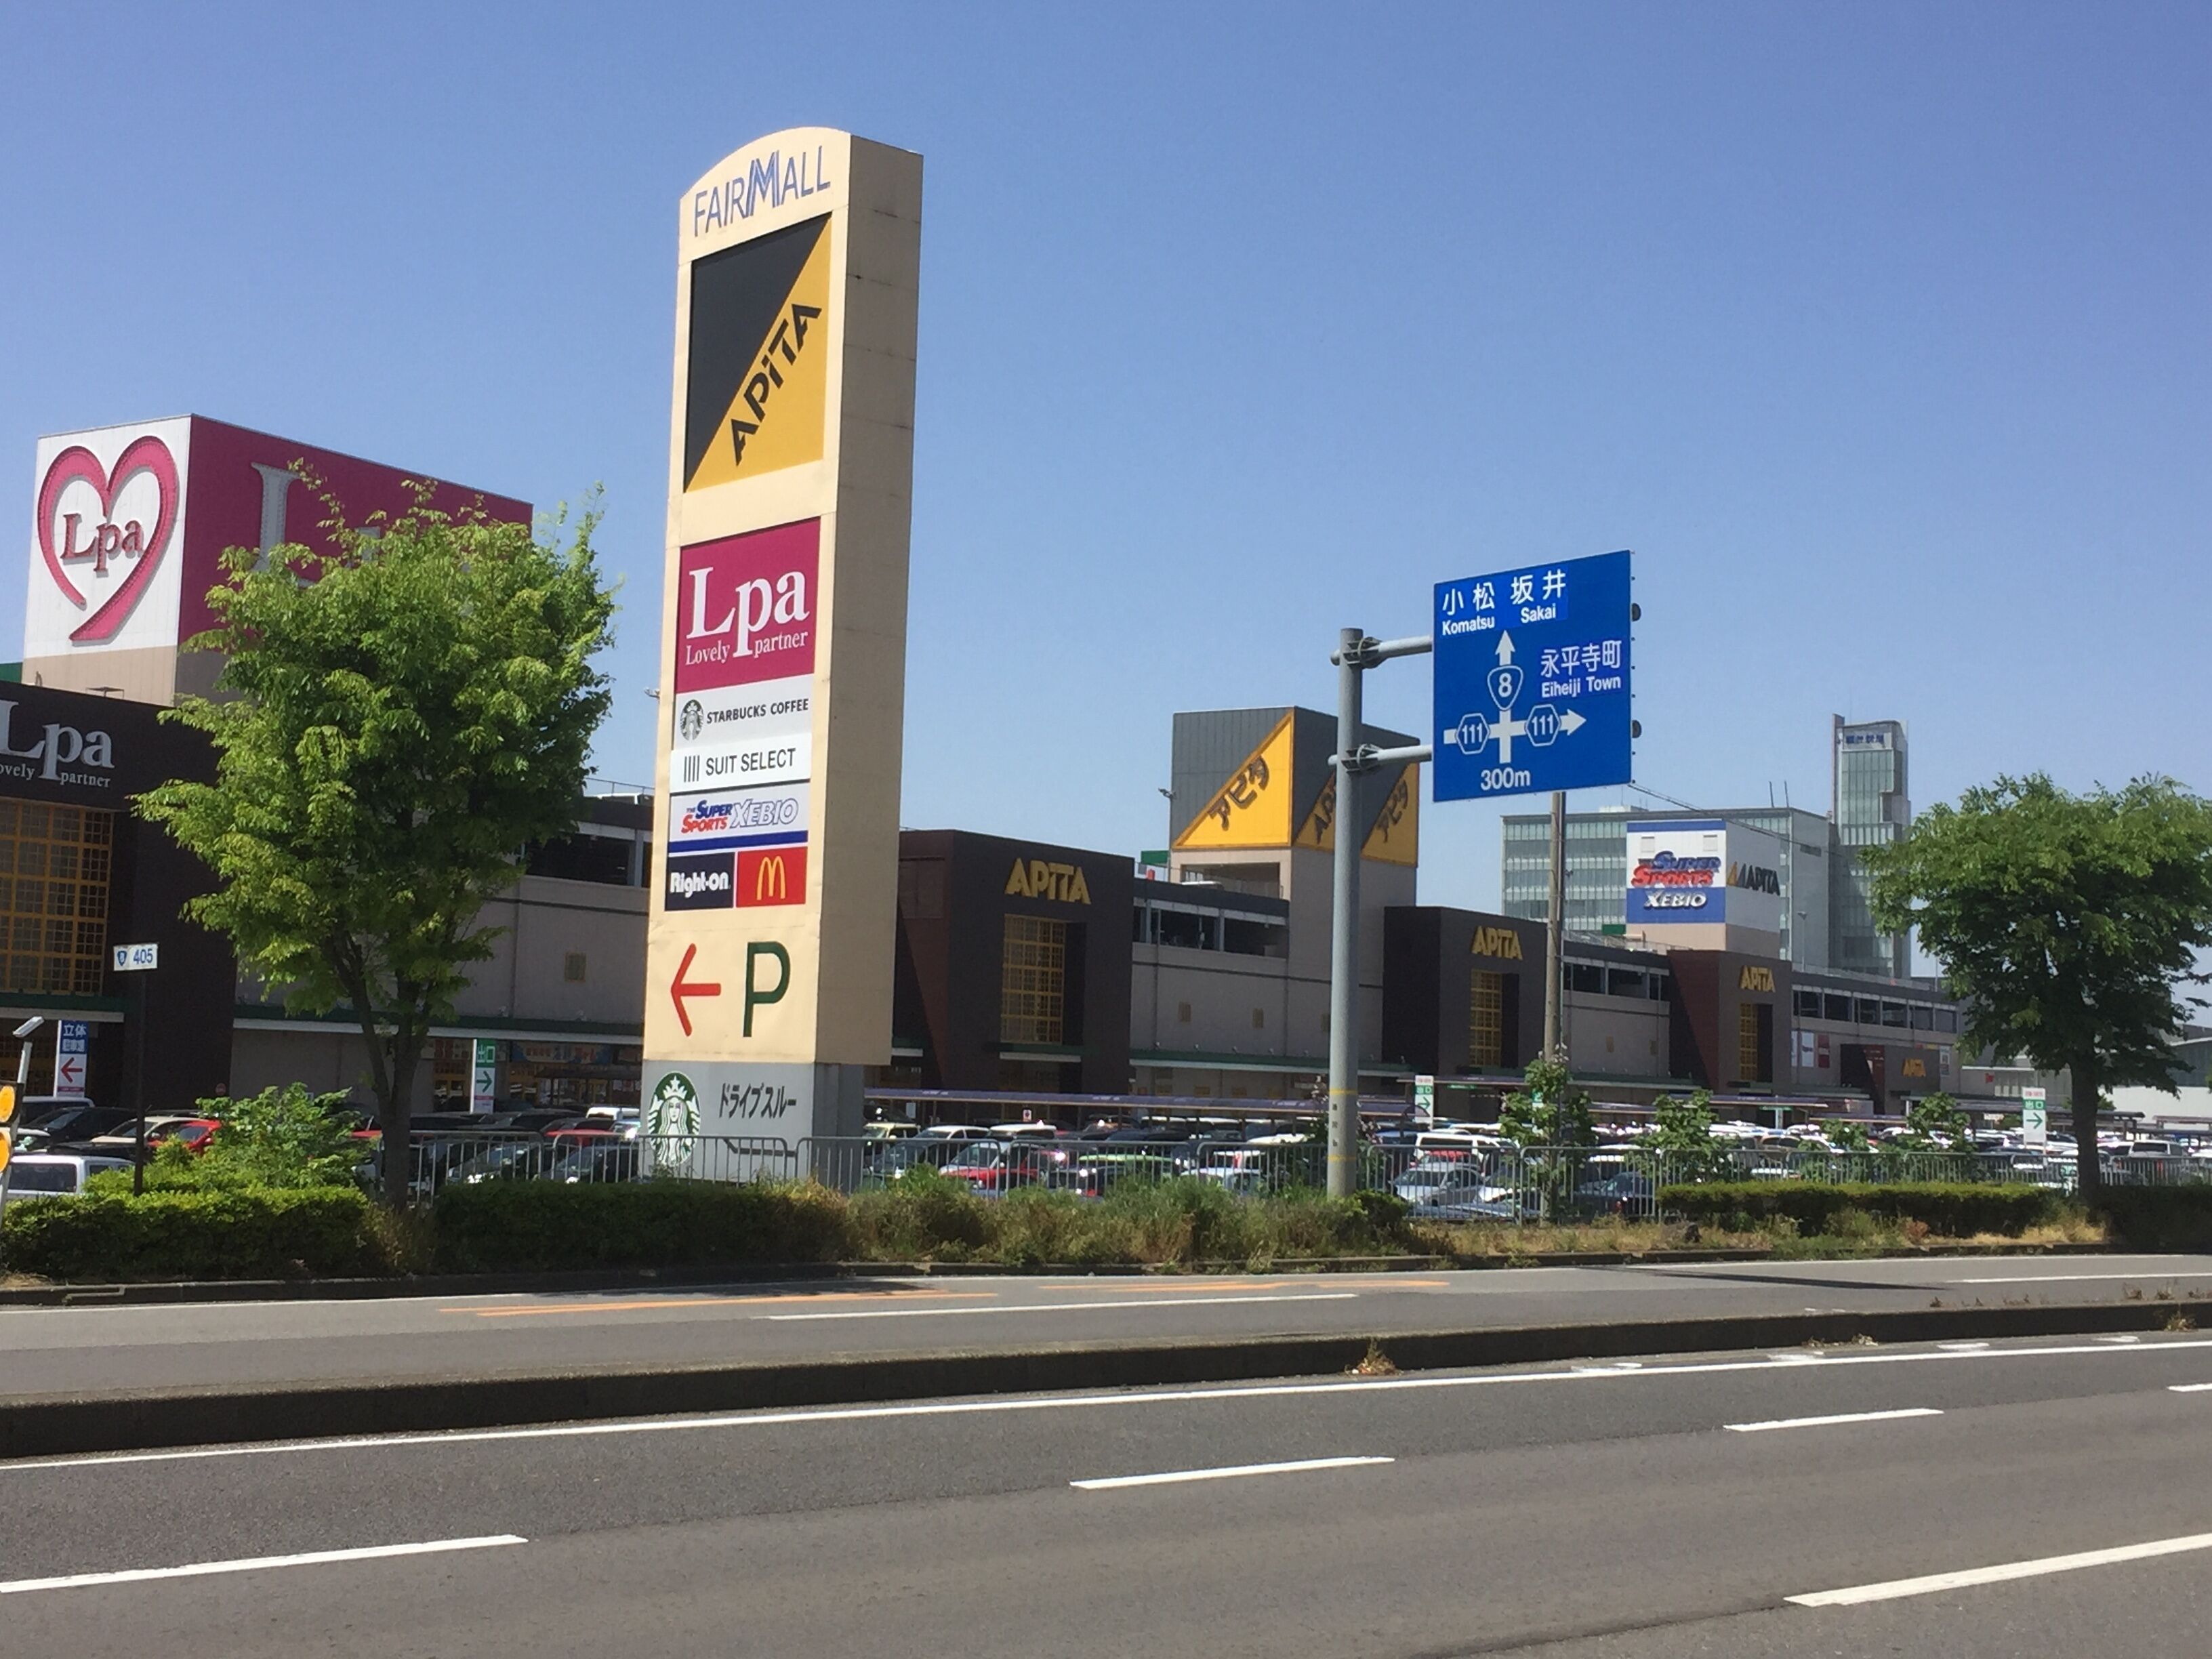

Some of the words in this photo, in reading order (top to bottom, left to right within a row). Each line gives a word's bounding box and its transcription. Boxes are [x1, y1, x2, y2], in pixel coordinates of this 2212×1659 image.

[60, 513, 144, 572] Lpa
[1442, 581, 1495, 616] 小松
[1510, 569, 1567, 605] 坂井
[686, 567, 810, 657] Lpa
[1441, 615, 1495, 636] Komatsu
[1520, 603, 1557, 623] Sakai
[685, 640, 730, 666] Lovely
[754, 632, 808, 659] partner
[1540, 640, 1622, 678] 永平寺町
[1498, 672, 1513, 698] 8
[1541, 679, 1581, 698] Eiheiji
[1586, 676, 1622, 692] Town
[706, 703, 766, 724] STARBUCKS
[770, 698, 809, 715] COFFEE
[1532, 714, 1554, 736] 111
[0, 699, 115, 781] Lpa
[1461, 724, 1483, 745] 111
[0, 763, 35, 780] ovely
[60, 771, 110, 788] partner
[705, 754, 737, 777] SUIT
[740, 747, 796, 773] SELECT
[1208, 755, 1269, 831] アピタ
[1480, 768, 1530, 790] 300m
[681, 815, 728, 834] SPORTS
[695, 800, 733, 819] SUPER
[730, 798, 798, 829] XEBIO
[1004, 857, 1091, 905] APITA
[1643, 890, 1707, 909] XEBIO
[134, 949, 153, 964] 405
[1471, 925, 1523, 960] APITA
[743, 941, 791, 1038] P
[720, 1083, 796, 1118] ドライブスルー
